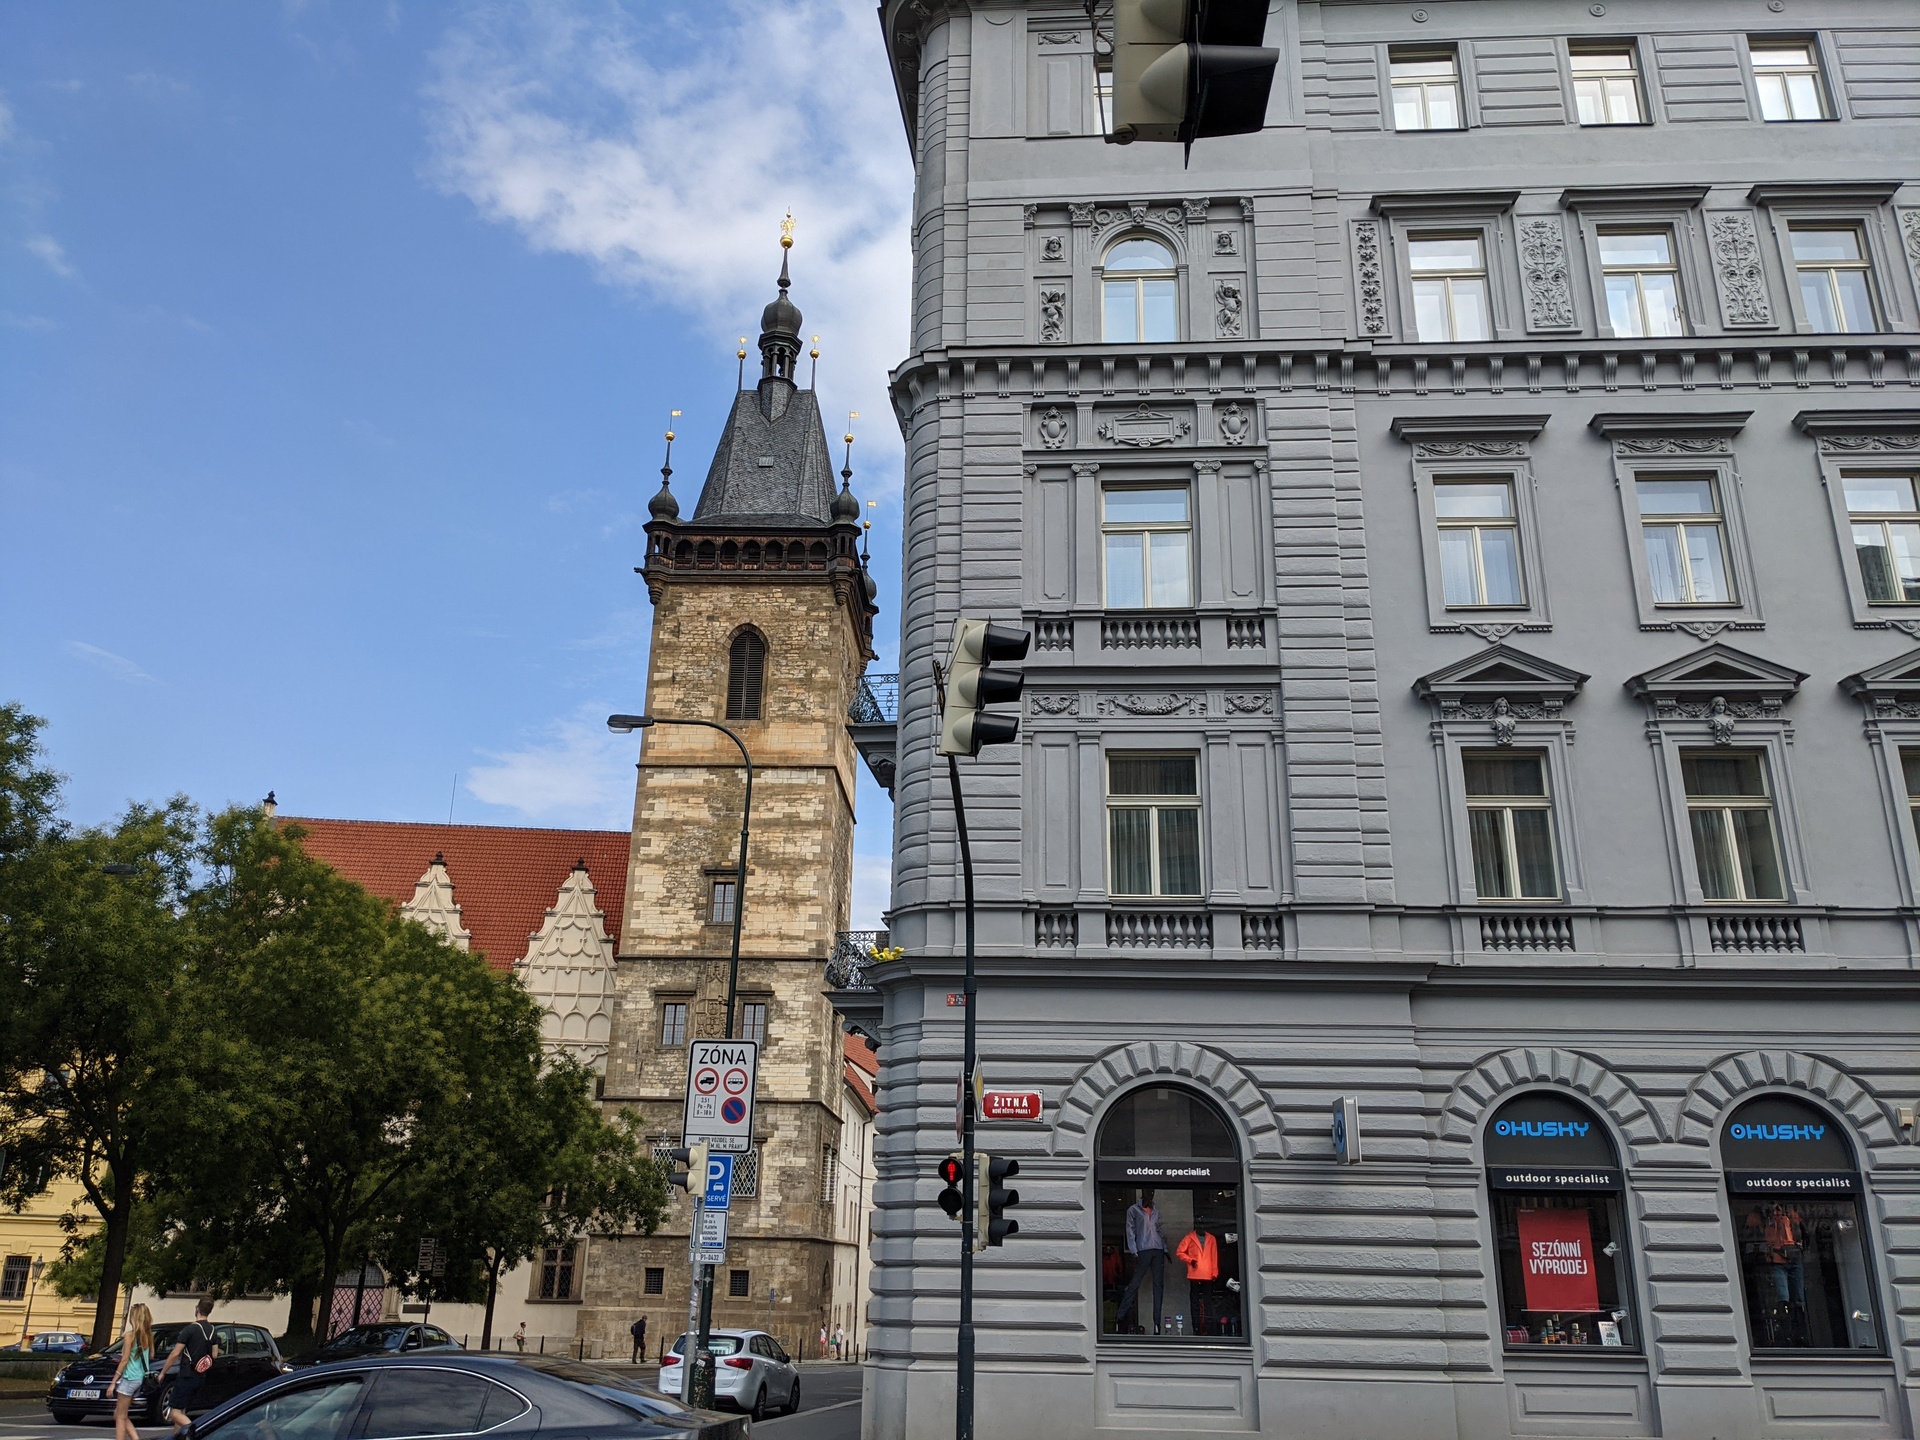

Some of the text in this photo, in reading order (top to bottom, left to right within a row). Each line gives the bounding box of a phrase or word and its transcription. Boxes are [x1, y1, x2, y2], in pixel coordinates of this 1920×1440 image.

[699, 1045, 747, 1065] ZÓNA
[994, 1096, 1028, 1107] ŽITNÁ
[1126, 1167, 1211, 1177] outdoor specialist
[1506, 1173, 1610, 1185] outdoor specialist
[1746, 1178, 1851, 1189] outdoor specialist
[1531, 1240, 1581, 1257] SEZÓNNÍ
[1529, 1257, 1588, 1275] VÝPRODEJ
